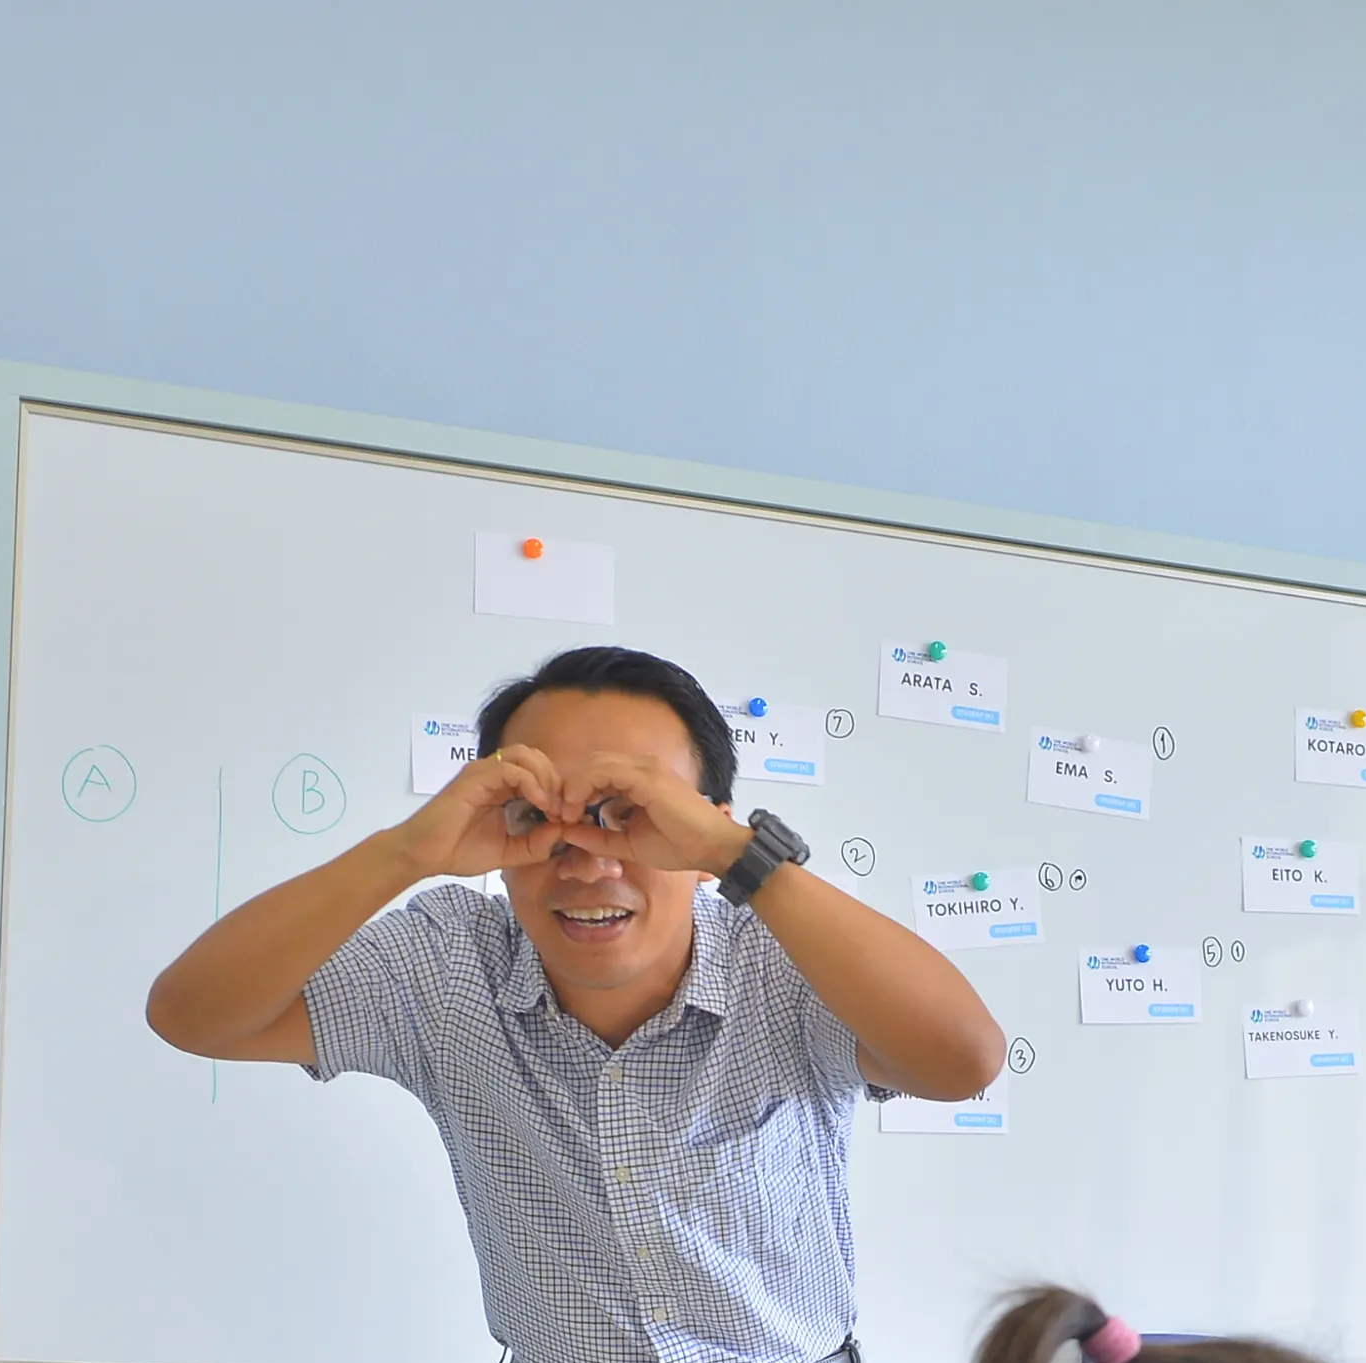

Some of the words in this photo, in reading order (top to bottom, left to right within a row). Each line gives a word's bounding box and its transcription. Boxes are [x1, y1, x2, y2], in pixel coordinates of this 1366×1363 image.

[900, 672, 953, 692] ARATA
[968, 682, 983, 697] S.
[768, 731, 784, 747] Y.
[1307, 738, 1366, 757] KOTARO
[77, 764, 112, 798] A
[1055, 761, 1089, 779] EMA
[1103, 769, 1118, 784] S.
[301, 769, 325, 815] B
[1272, 868, 1303, 882] EITO
[1314, 869, 1328, 883] K.
[926, 898, 1002, 917] TOKIHIRO
[1009, 897, 1024, 911] Y.
[1105, 978, 1145, 992] YUTO
[1153, 978, 1168, 992] H.
[1248, 1029, 1321, 1042] TAKENOSUKE
[1328, 1029, 1339, 1039] Y.
